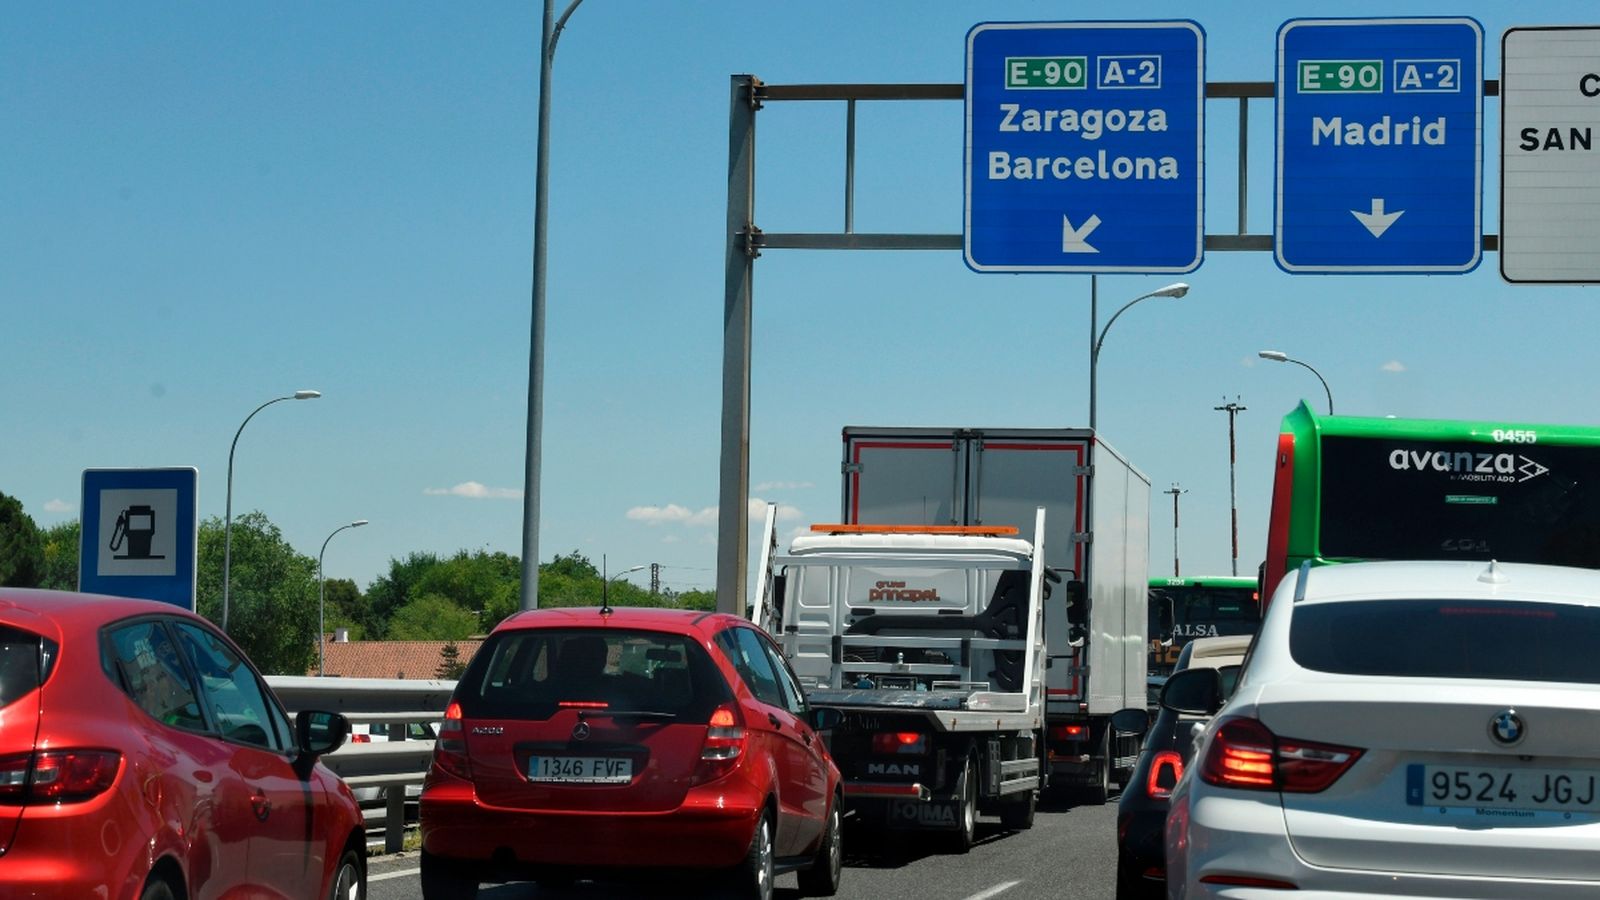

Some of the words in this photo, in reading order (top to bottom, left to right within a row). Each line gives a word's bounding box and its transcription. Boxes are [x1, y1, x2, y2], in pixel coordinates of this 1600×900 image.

[1010, 61, 1083, 85] E-90
[1103, 60, 1156, 84] A-2
[1302, 64, 1379, 89] E-90
[1400, 64, 1455, 88] A-2
[999, 103, 1169, 140] Zaragoza
[1312, 115, 1447, 146] Madrid
[1519, 127, 1592, 151] SAN
[988, 149, 1180, 180] Barcelona
[1494, 429, 1537, 444] 0455
[1388, 449, 1516, 474] avanza
[1173, 624, 1219, 637] ALSA
[543, 759, 584, 776] 1346
[593, 760, 626, 777] FVF
[868, 763, 920, 775] MAN
[1432, 771, 1517, 802] 9524
[1532, 774, 1595, 805] JGJ
[1475, 807, 1535, 818] Momentum
